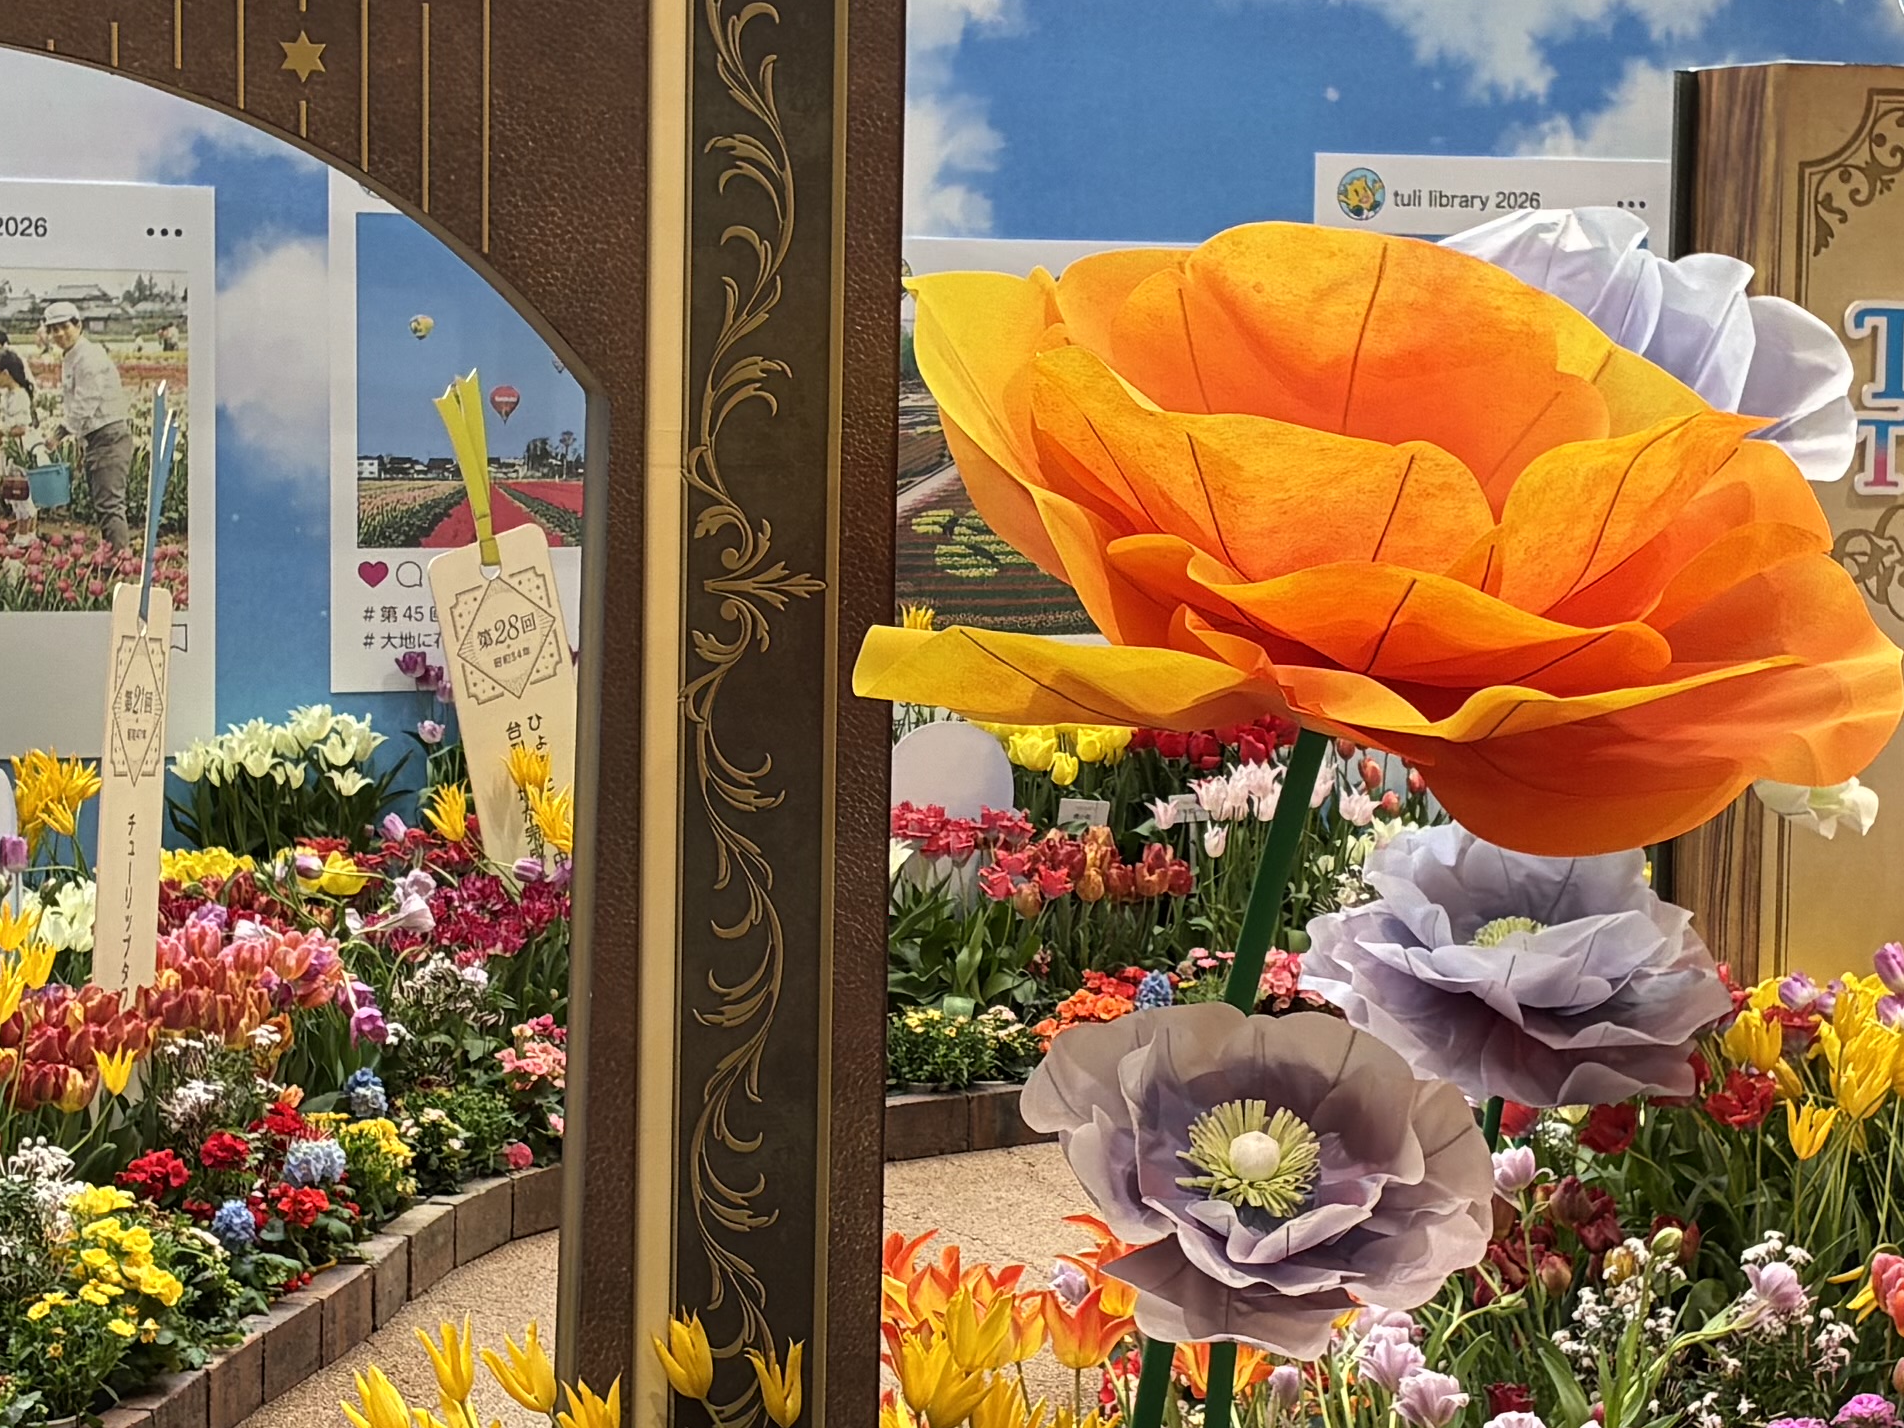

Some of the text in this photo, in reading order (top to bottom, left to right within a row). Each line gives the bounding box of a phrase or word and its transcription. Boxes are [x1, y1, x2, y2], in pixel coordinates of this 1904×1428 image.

[1393, 189, 1542, 212] tuli library 2026
[477, 611, 537, 651] 第28回
